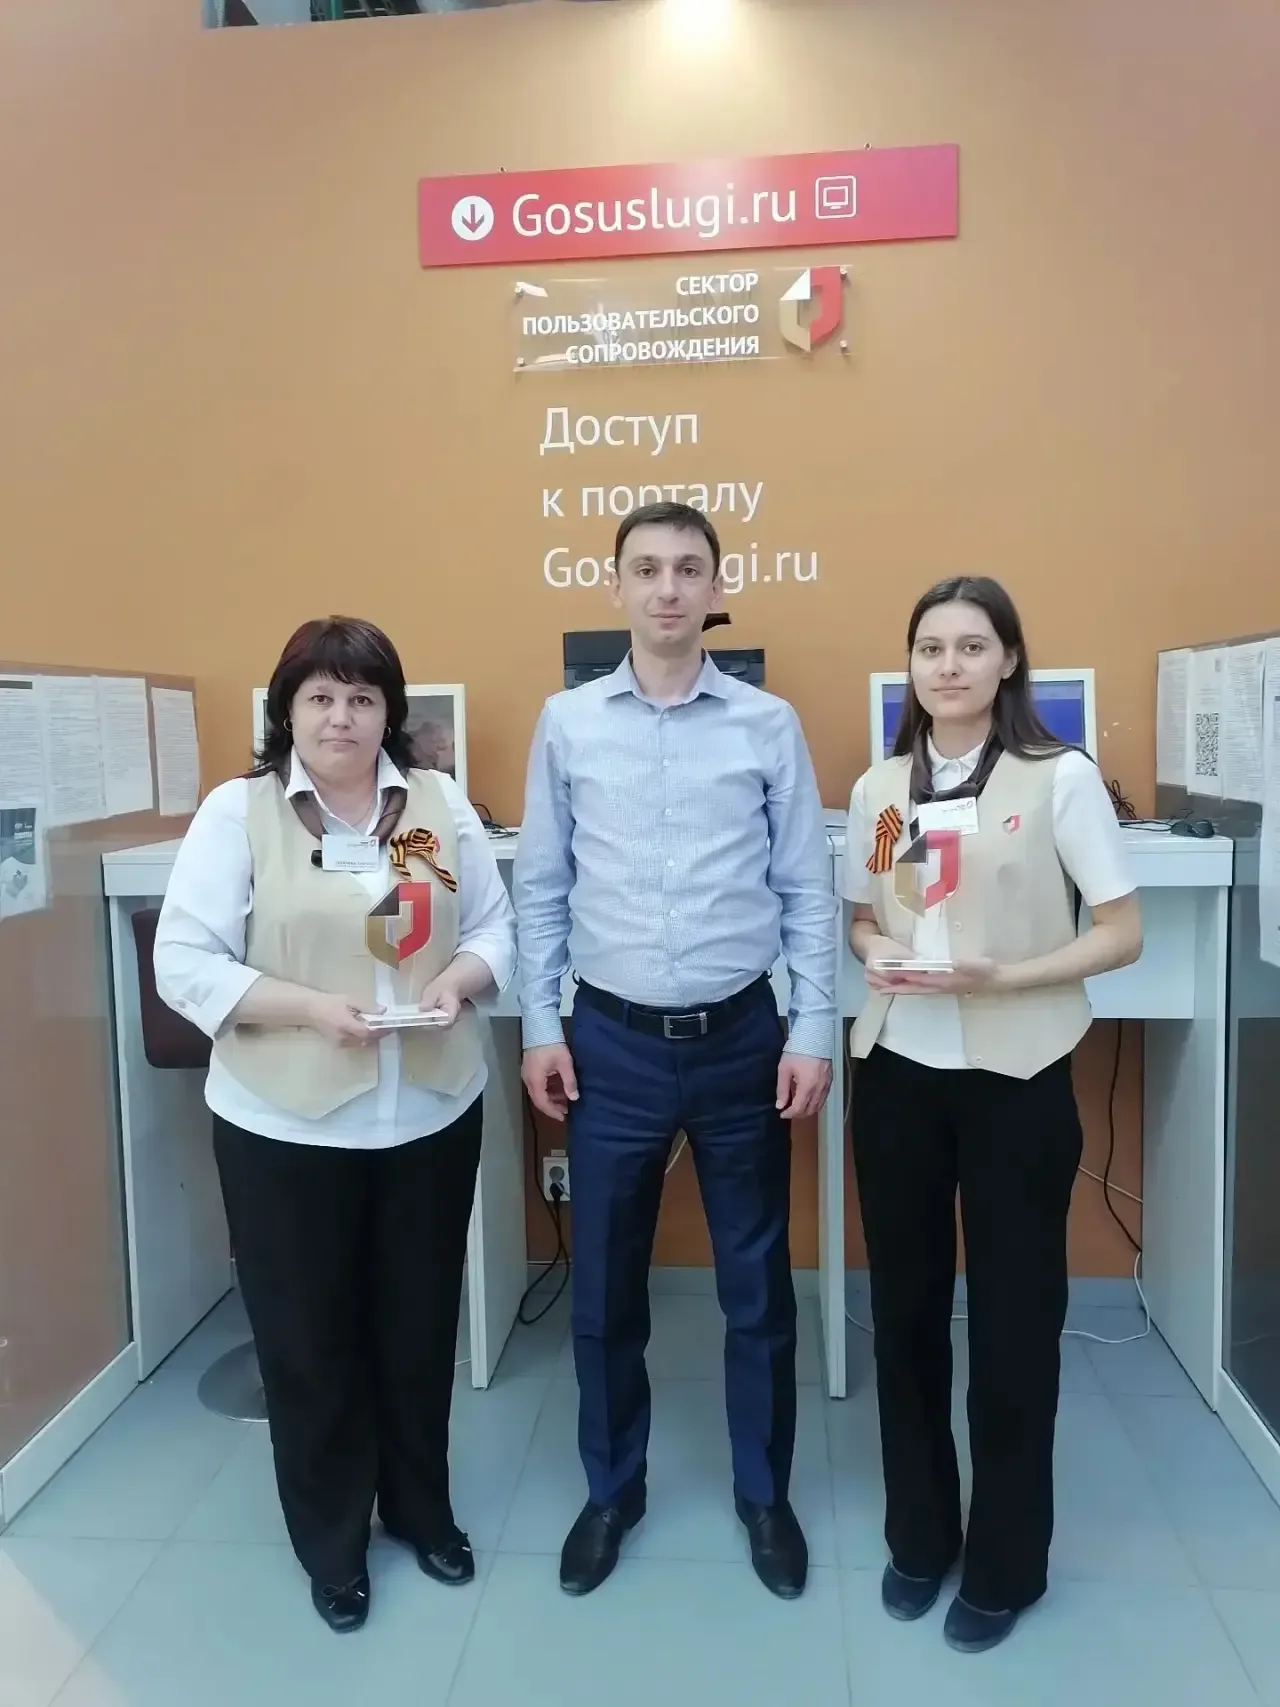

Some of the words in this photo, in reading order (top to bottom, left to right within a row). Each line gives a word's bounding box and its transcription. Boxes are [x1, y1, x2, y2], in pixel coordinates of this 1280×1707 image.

[512, 182, 798, 238] Gosuslugi.ru
[675, 272, 759, 296] СЕКТОР
[522, 303, 760, 336] ПОЛЬЗОВАТЕЛЬСКОГО
[565, 335, 760, 365] СОПРОВОЖДЕНИЯ
[539, 406, 699, 456] Доступ
[541, 487, 566, 518] к
[542, 541, 819, 594] Gosgi.ru
